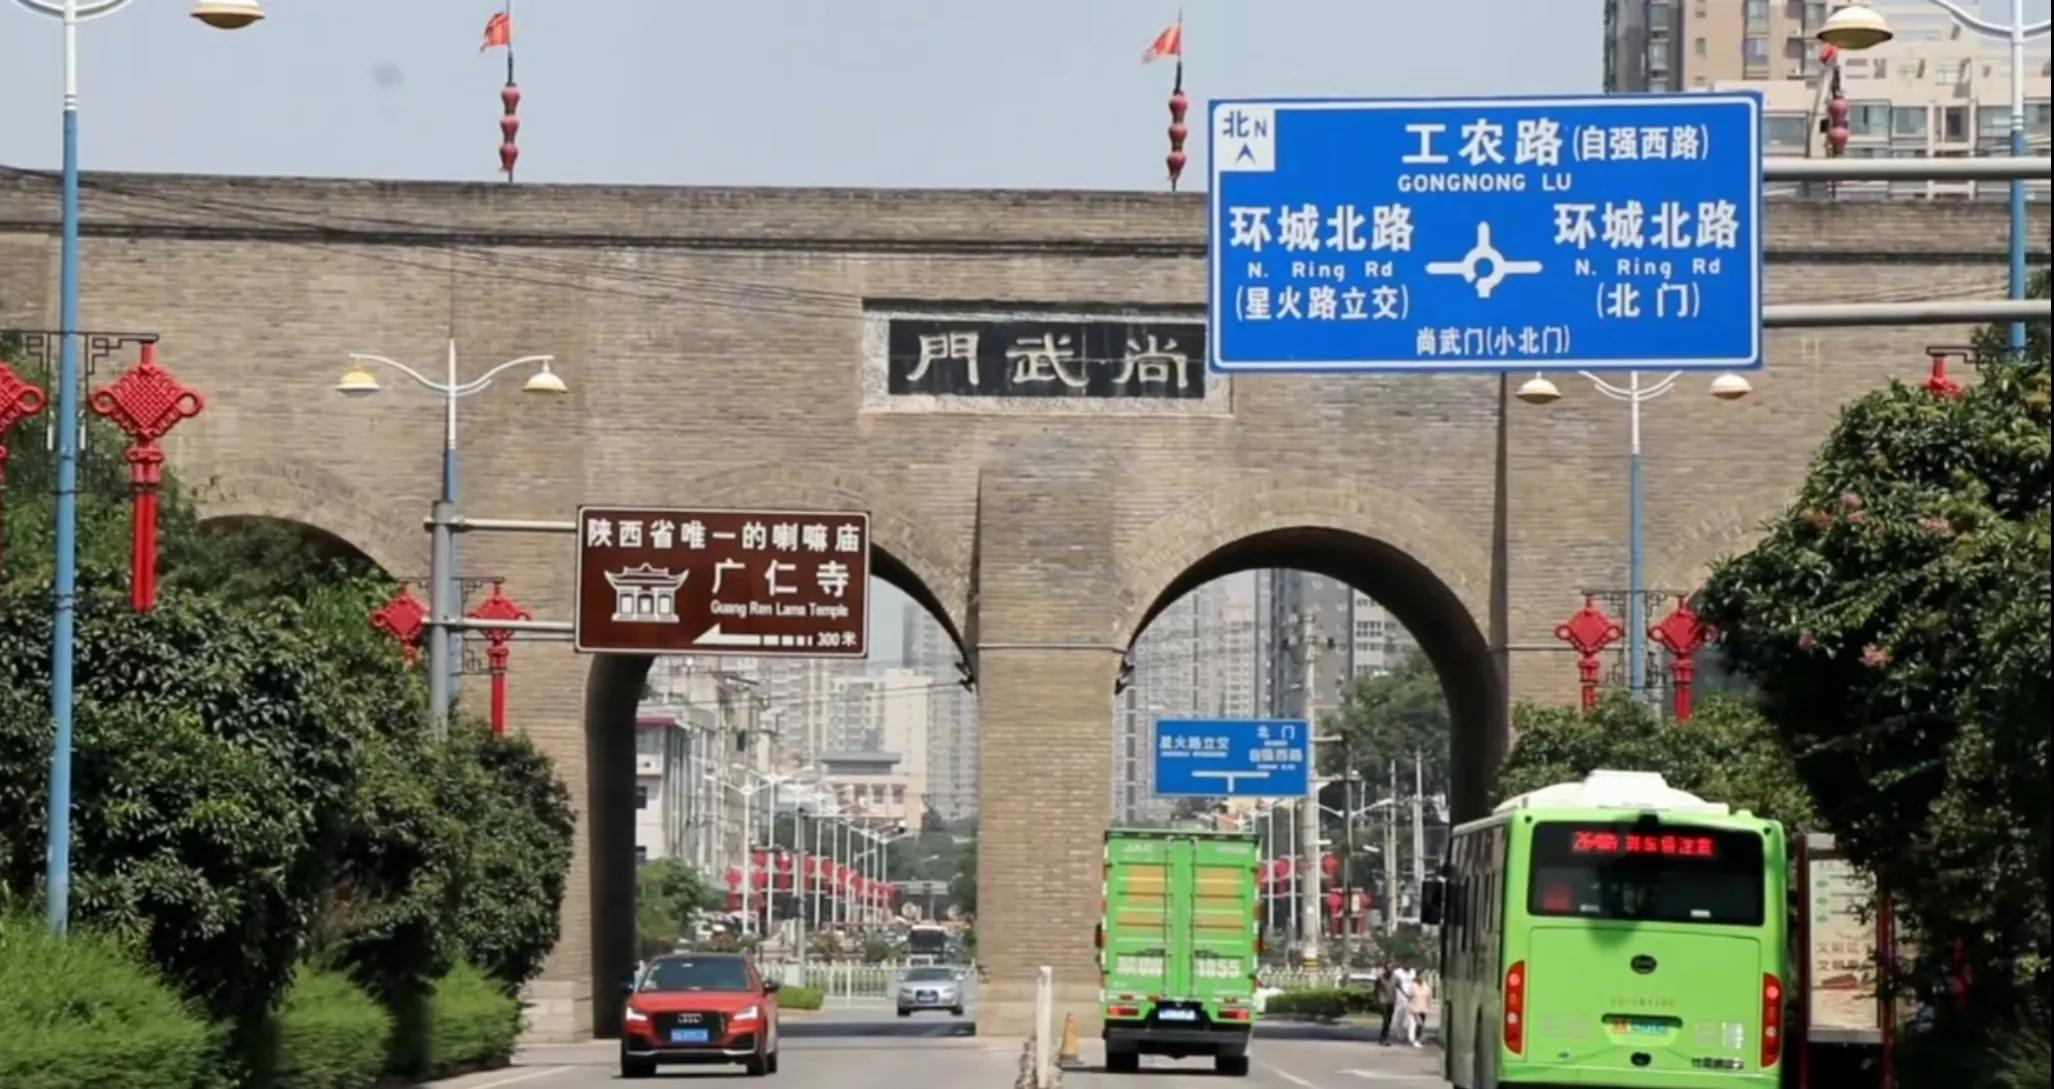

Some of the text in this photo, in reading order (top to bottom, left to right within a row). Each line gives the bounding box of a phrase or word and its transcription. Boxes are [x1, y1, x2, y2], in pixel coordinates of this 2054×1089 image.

[1402, 118, 1708, 166] 工农路 (自强西路)
[1398, 173, 1571, 192] GONGNONG LU
[1229, 203, 1414, 252] 环城北路
[1553, 199, 1739, 250] 环城北路
[1248, 261, 1393, 281] N. Ring Rd
[1575, 258, 1721, 279] N. Ring Rd
[1236, 285, 1409, 320] (星火路立交)
[1416, 326, 1570, 356] 尚武门(小北门)
[587, 518, 861, 552] 陕西省唯一的喇嘛庙
[711, 557, 850, 598] 广仁寺
[710, 599, 849, 620] Guang Ren Lama Temple
